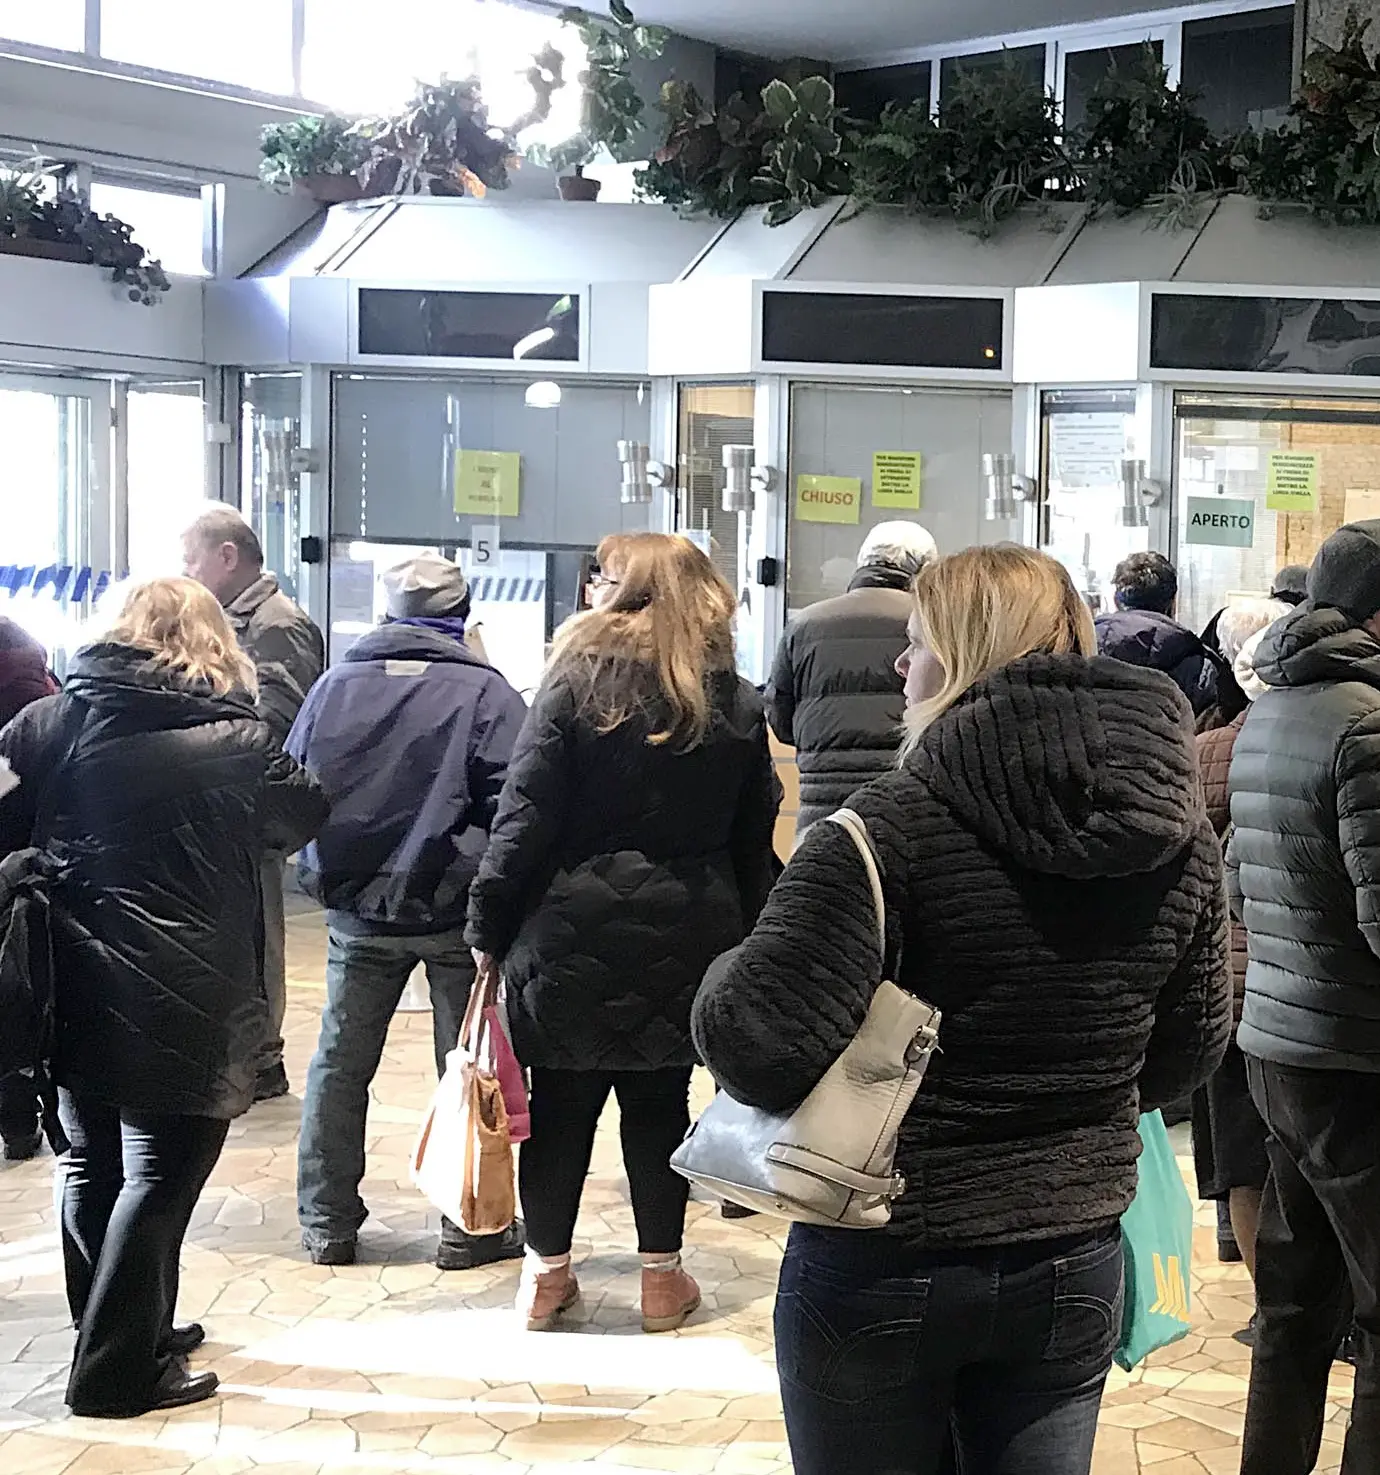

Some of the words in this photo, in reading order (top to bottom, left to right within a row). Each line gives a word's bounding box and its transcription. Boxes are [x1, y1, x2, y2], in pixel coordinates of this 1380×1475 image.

[801, 490, 854, 506] CHIUSO
[1191, 512, 1250, 529] APERTO
[477, 541, 490, 563] 5
